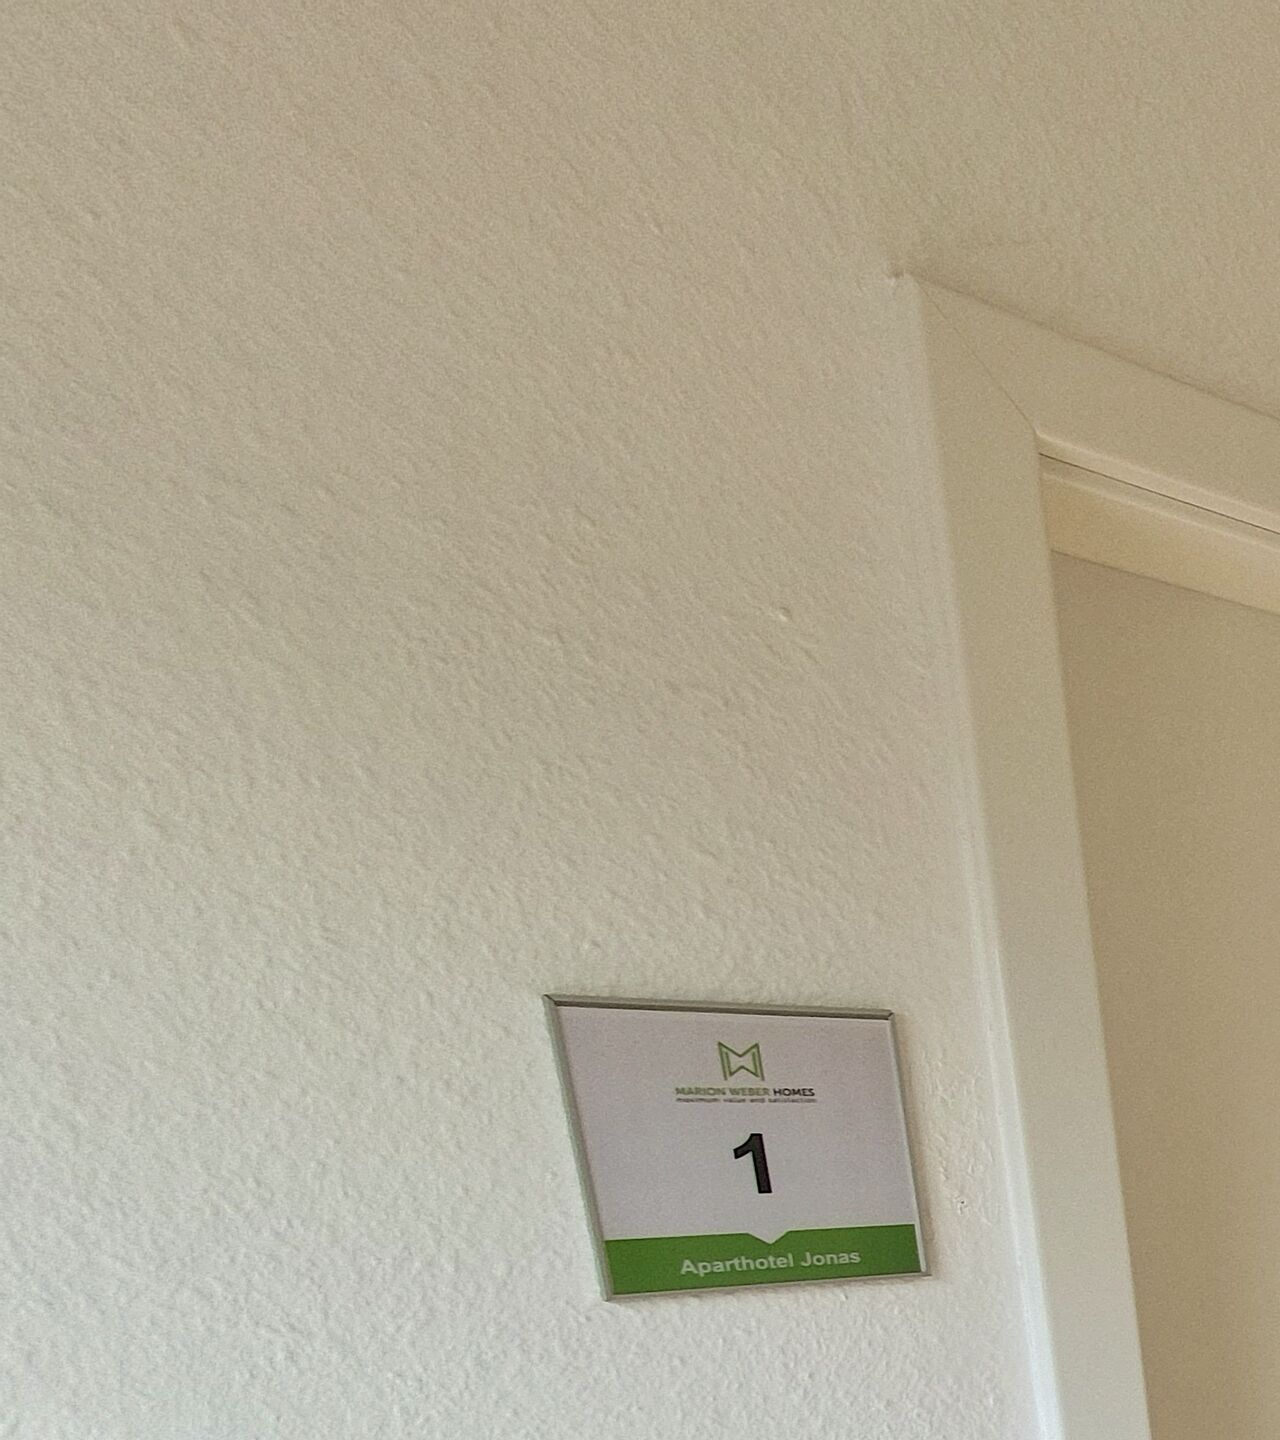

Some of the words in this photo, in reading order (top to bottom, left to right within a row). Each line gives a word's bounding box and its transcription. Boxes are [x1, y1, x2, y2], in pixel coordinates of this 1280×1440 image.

[675, 1087, 726, 1096] MARION
[729, 1087, 770, 1097] WEBER
[773, 1087, 816, 1097] HOMES
[733, 1132, 773, 1194] 1
[680, 1253, 795, 1277] Aparthotel
[801, 1252, 862, 1267] Jonas
